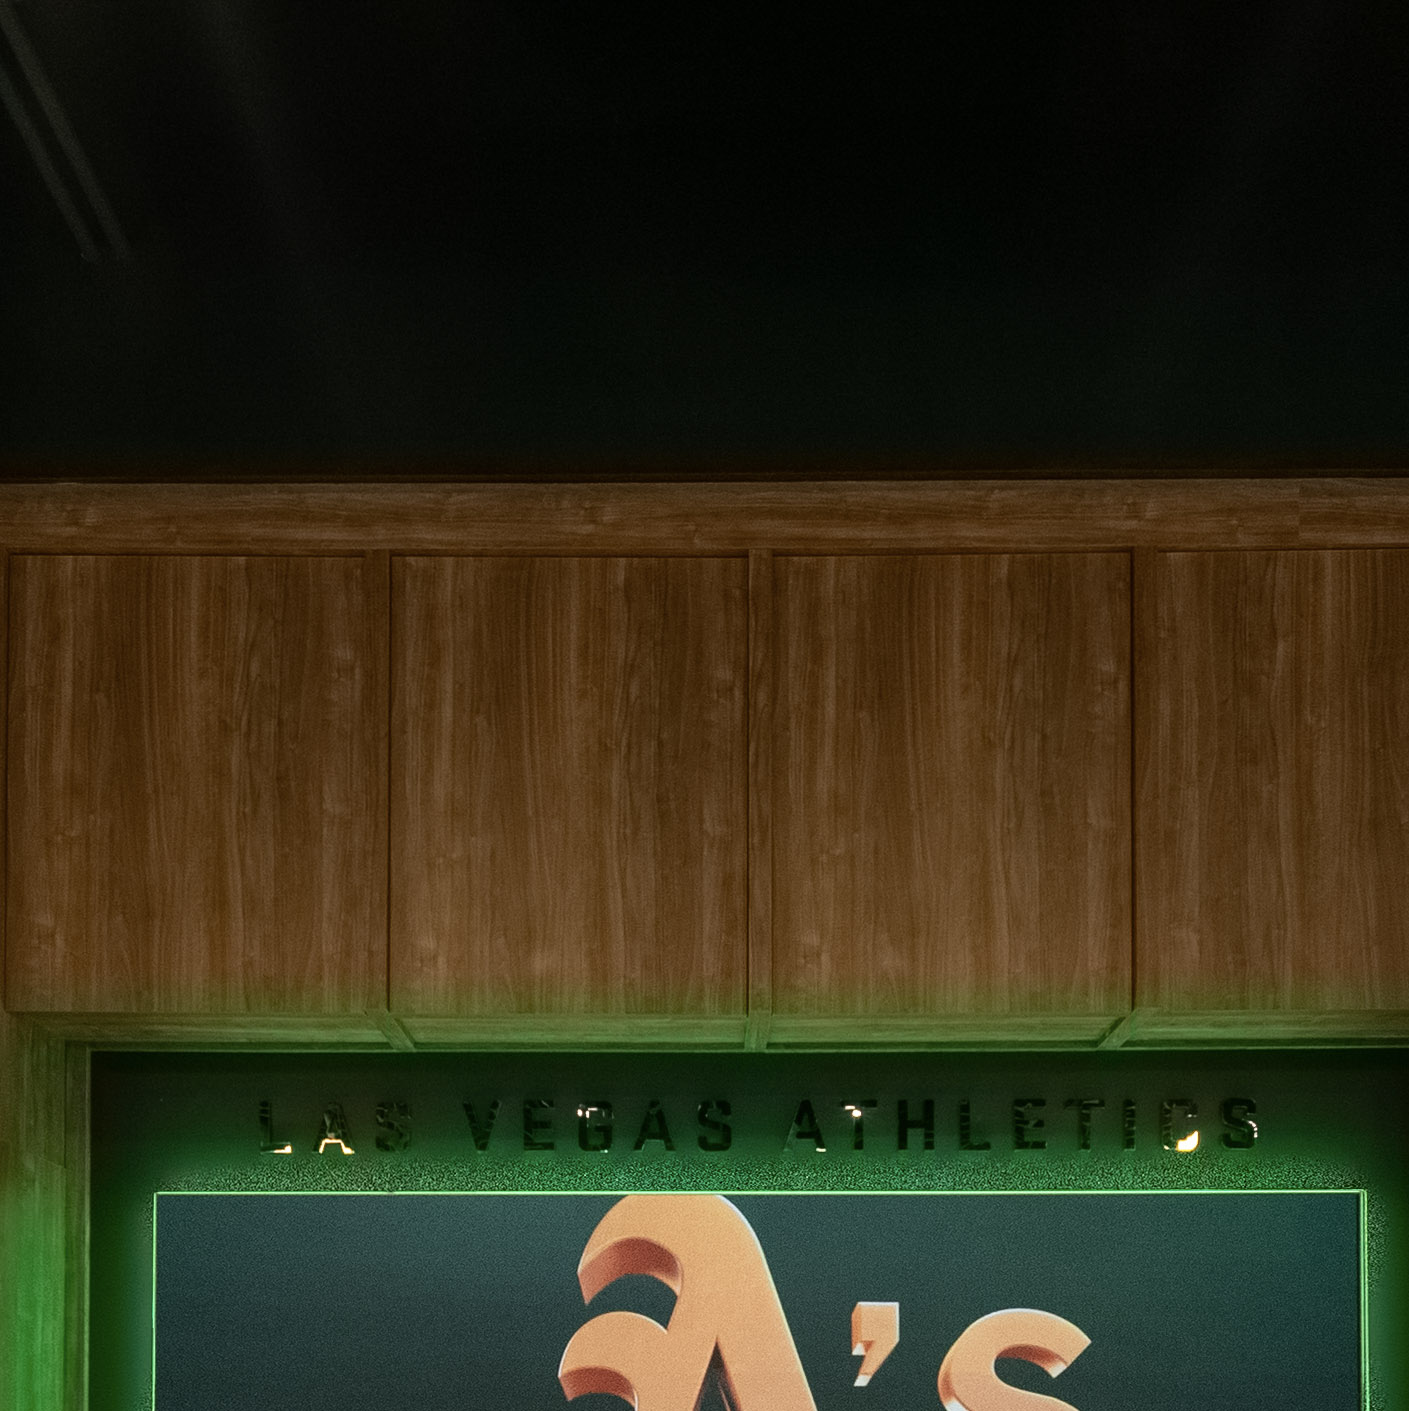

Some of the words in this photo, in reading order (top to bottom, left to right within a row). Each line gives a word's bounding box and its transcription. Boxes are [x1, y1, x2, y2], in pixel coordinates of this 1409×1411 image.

[258, 1100, 413, 1153] LAS
[462, 1099, 732, 1153] VEGAS
[783, 1098, 1258, 1153] ATHLETICS
